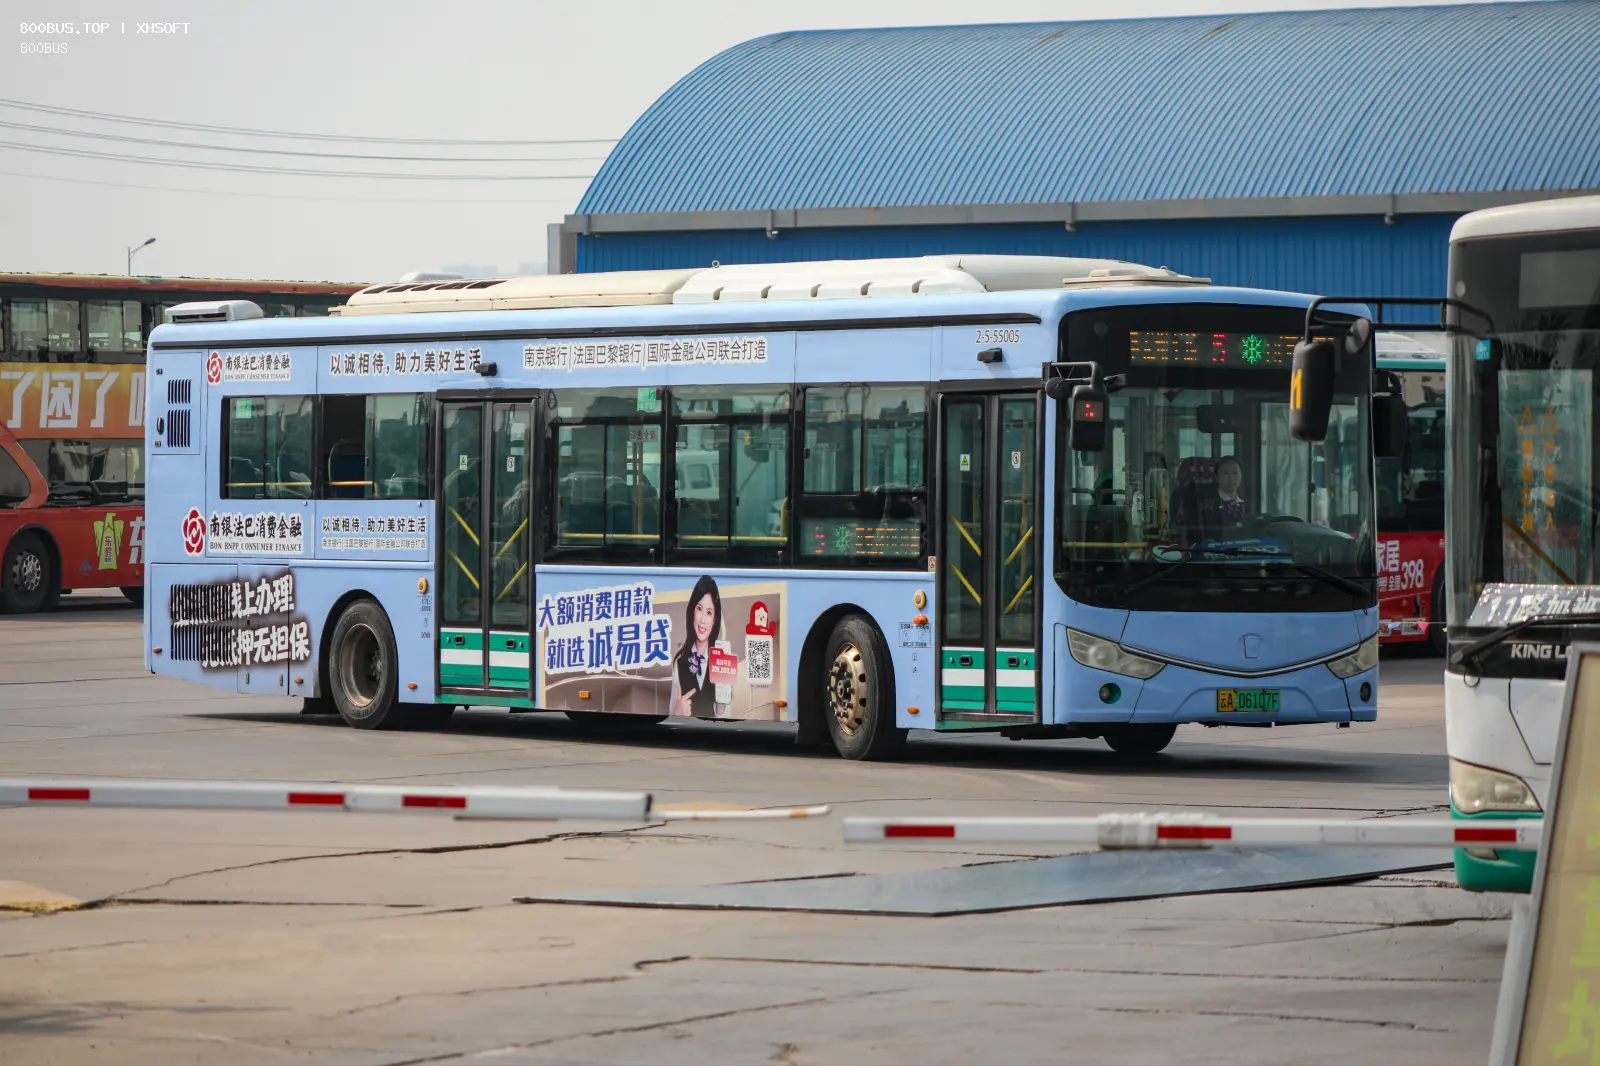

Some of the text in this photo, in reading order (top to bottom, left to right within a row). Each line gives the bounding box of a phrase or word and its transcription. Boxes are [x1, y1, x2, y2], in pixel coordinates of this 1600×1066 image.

[975, 328, 1020, 344] 2-5-55005
[225, 353, 291, 371] 南银法巴消费金融
[330, 348, 483, 375] 以诚相待，助力美好生活
[209, 513, 303, 539] 南银法巴消费金融
[322, 516, 427, 533] 以诚相待，助力美好生活
[209, 541, 303, 552] BON BNPP CONSUMER FINANCE
[1401, 558, 1425, 590] 398
[538, 586, 653, 628] 大额消费用款
[547, 619, 671, 670] 就选诚易贷
[1511, 644, 1553, 659] KING
[1220, 691, 1279, 709] 云A 06107F
